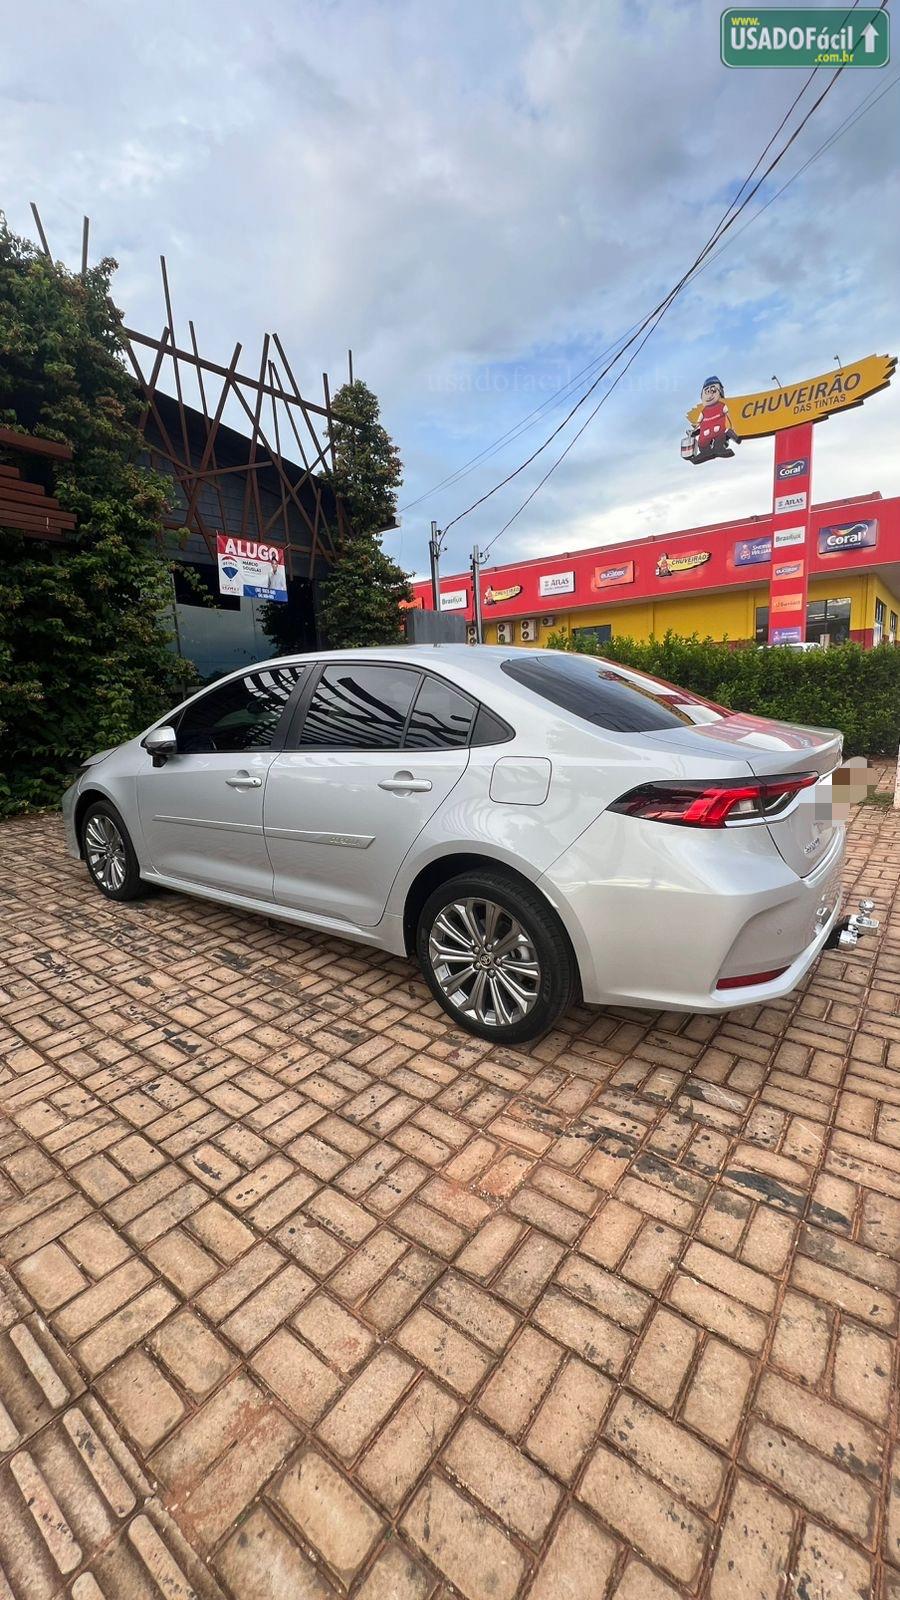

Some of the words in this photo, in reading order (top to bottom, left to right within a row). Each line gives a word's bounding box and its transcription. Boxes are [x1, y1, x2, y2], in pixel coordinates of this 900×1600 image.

[741, 371, 861, 419] CHUVEIRÃO
[793, 402, 812, 415] DAS
[815, 394, 846, 410] TINTAS
[779, 465, 801, 476] Coral
[826, 531, 862, 546] Coral
[225, 538, 279, 561] ALUGO
